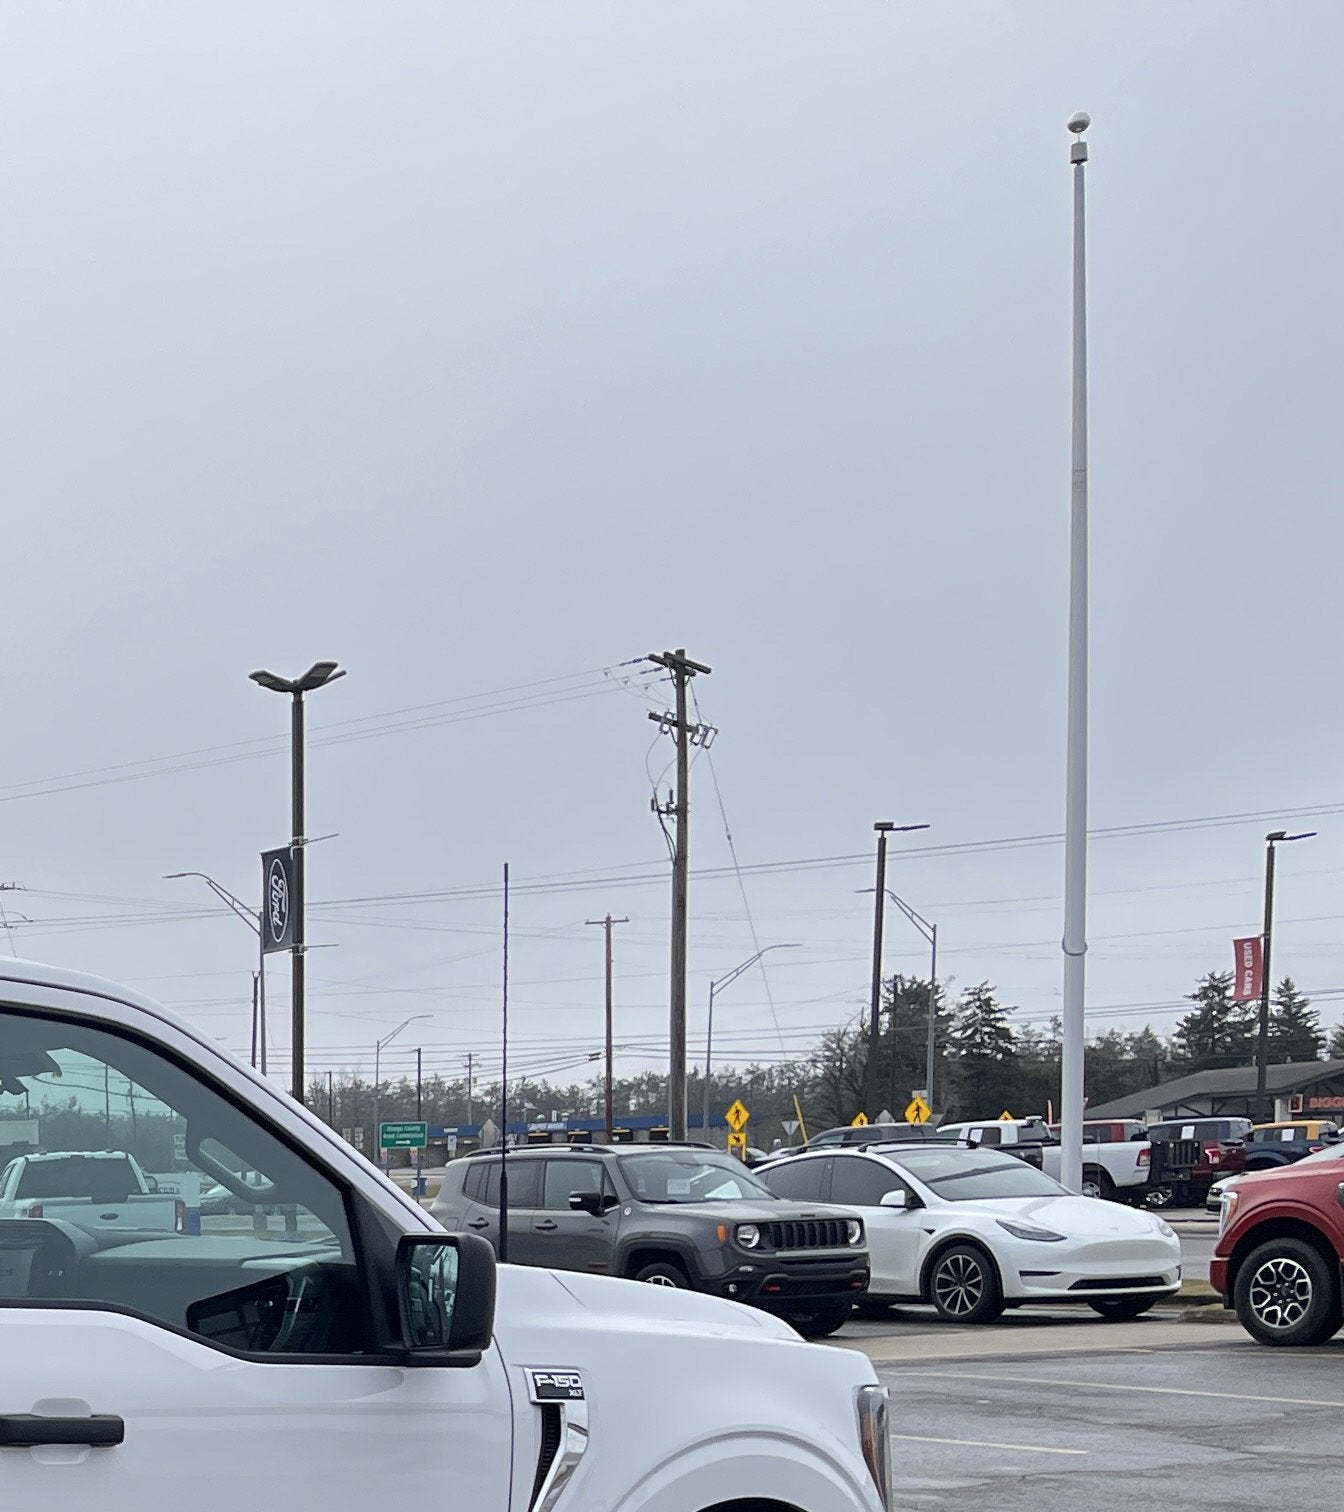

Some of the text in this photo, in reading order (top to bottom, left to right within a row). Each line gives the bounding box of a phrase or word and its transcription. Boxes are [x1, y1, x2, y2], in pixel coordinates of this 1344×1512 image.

[272, 874, 286, 927] Ford
[1243, 942, 1253, 996] USED CARS
[1309, 1096, 1344, 1109] BIGG
[534, 1374, 583, 1388] F-150
[568, 1389, 583, 1397] XLT
